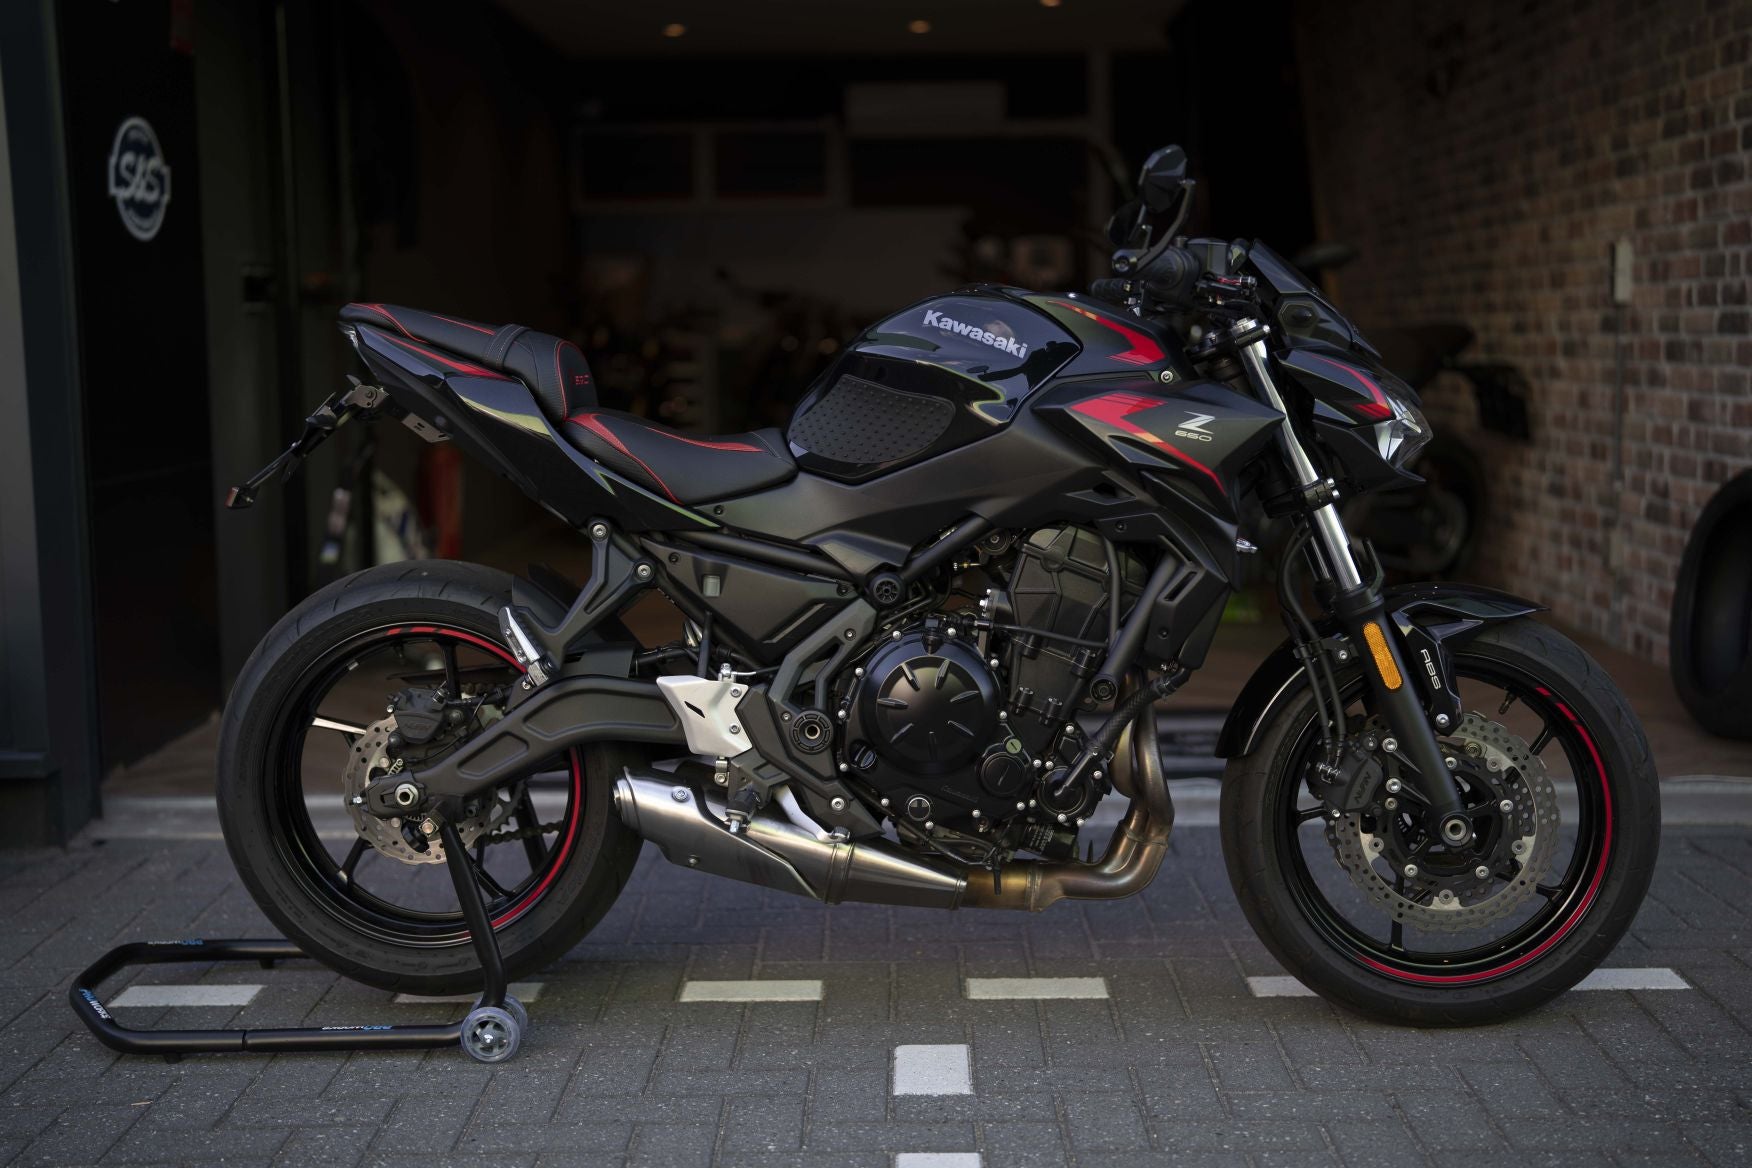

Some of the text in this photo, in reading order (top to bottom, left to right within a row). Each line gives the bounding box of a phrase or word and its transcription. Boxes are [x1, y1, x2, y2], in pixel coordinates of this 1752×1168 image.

[922, 309, 1029, 359] Kawasaki
[1174, 429, 1213, 442] 650
[1177, 410, 1216, 435] Z
[1420, 648, 1442, 690] ABS
